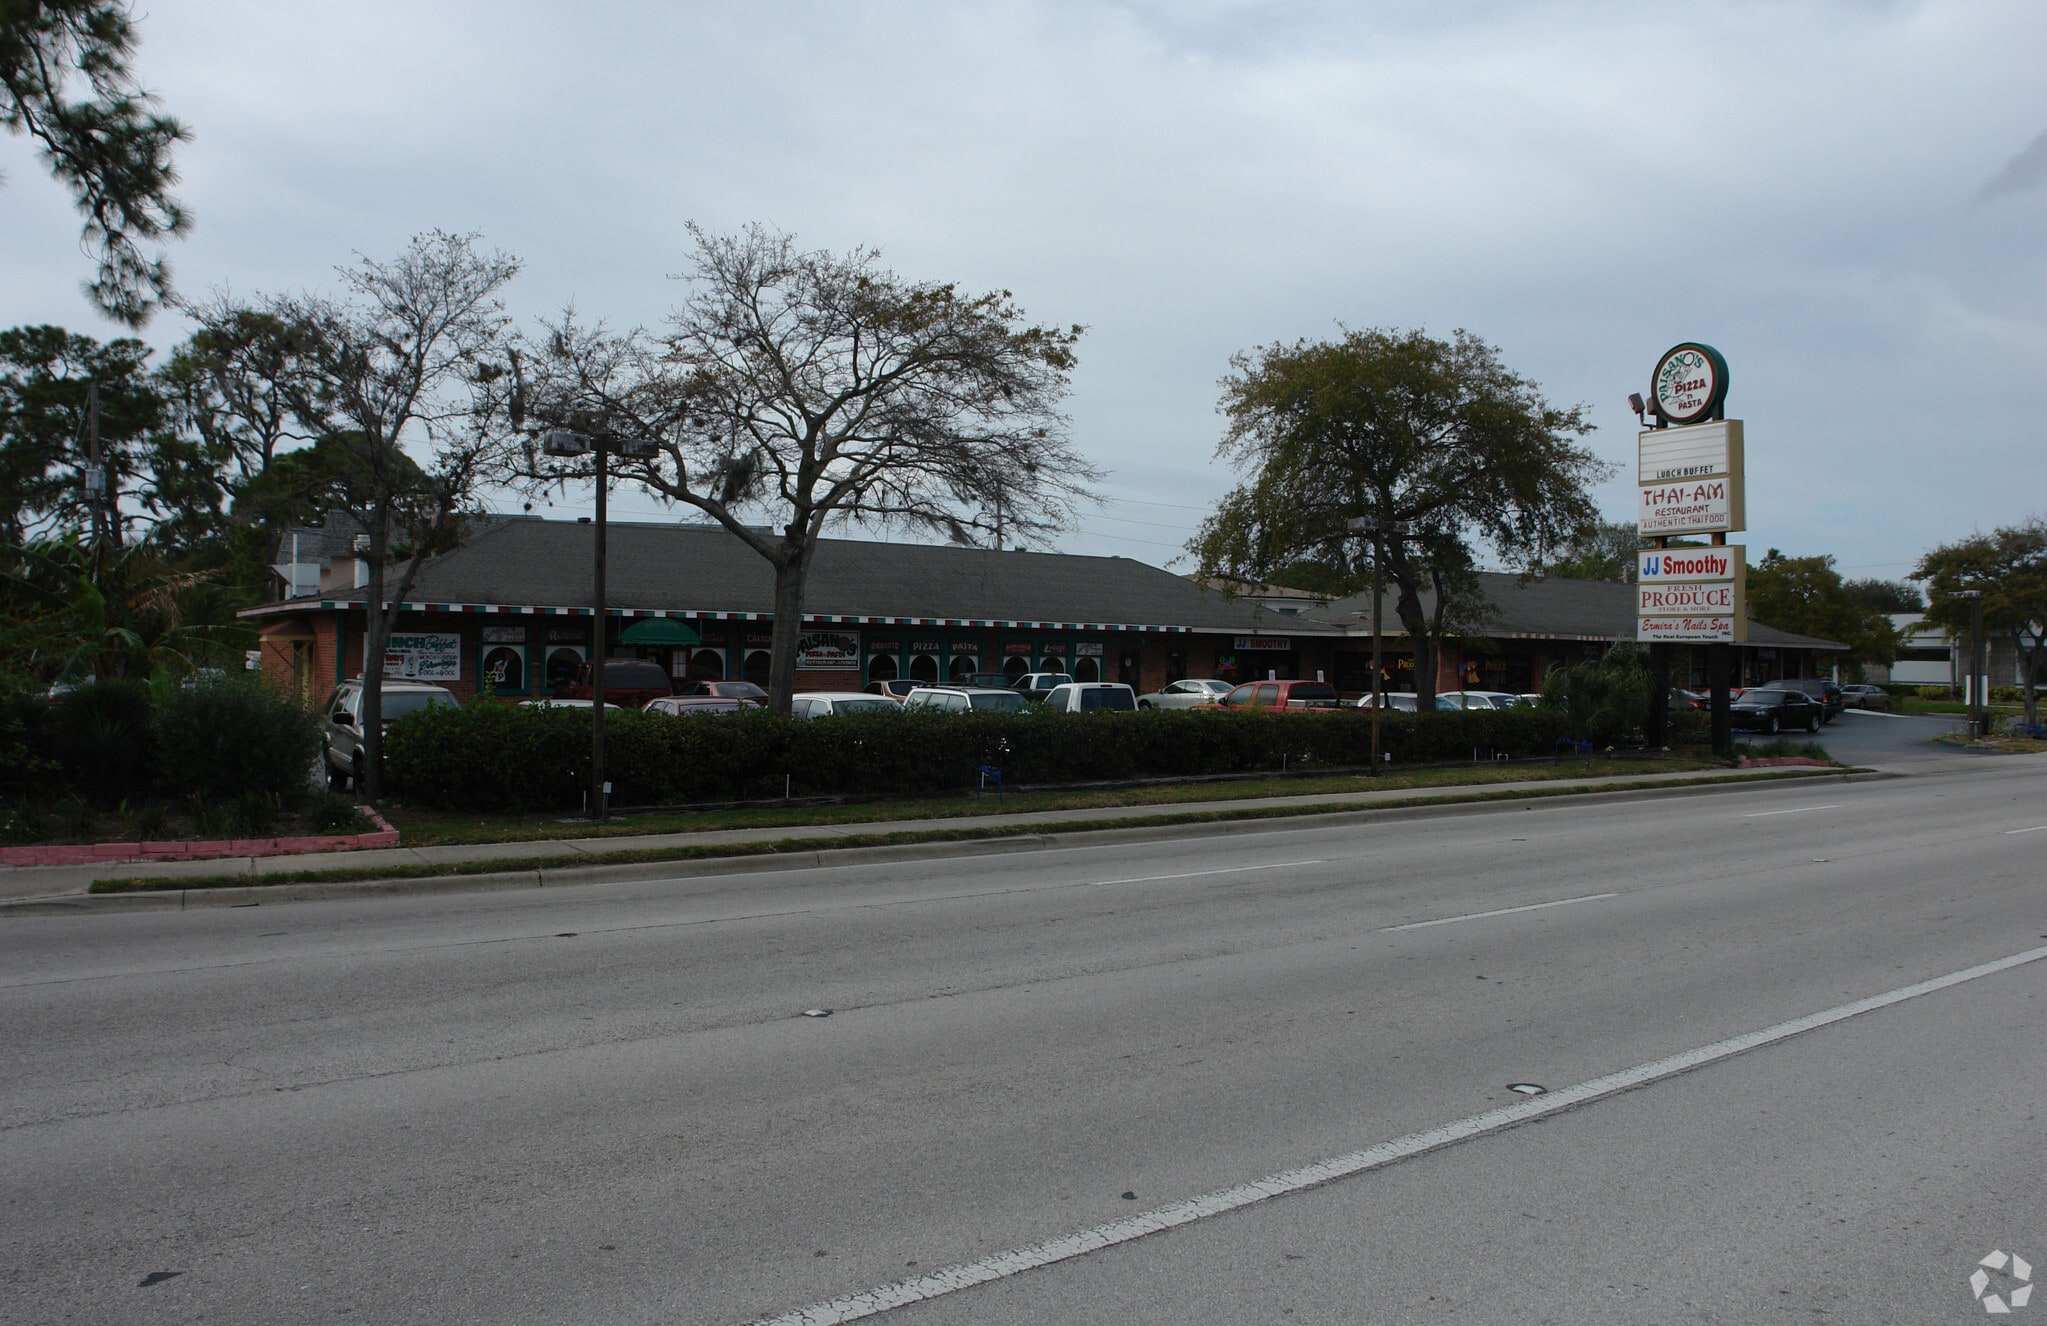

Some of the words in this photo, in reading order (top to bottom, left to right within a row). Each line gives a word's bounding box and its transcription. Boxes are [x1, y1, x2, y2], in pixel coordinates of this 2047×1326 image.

[1659, 351, 1705, 403] PAISANO'S
[1674, 378, 1707, 395] PIZZA
[1678, 399, 1703, 411] PASTA
[1656, 467, 1682, 479] LUNCH
[1684, 465, 1714, 477] BUFFET
[1643, 482, 1724, 506] THAI-AM
[1655, 504, 1709, 517] RESTAURANT
[1643, 556, 1659, 576] JJ
[1663, 554, 1727, 576] Smoothy
[1667, 584, 1702, 592] FRESH
[1641, 588, 1730, 608] PRODUCE
[1682, 618, 1707, 631] Nails
[1709, 618, 1729, 632] Spa
[912, 642, 939, 650] PIZZA
[952, 643, 977, 651] PASTA
[1236, 639, 1246, 648] JJ
[1250, 639, 1288, 648] SMOOTHY
